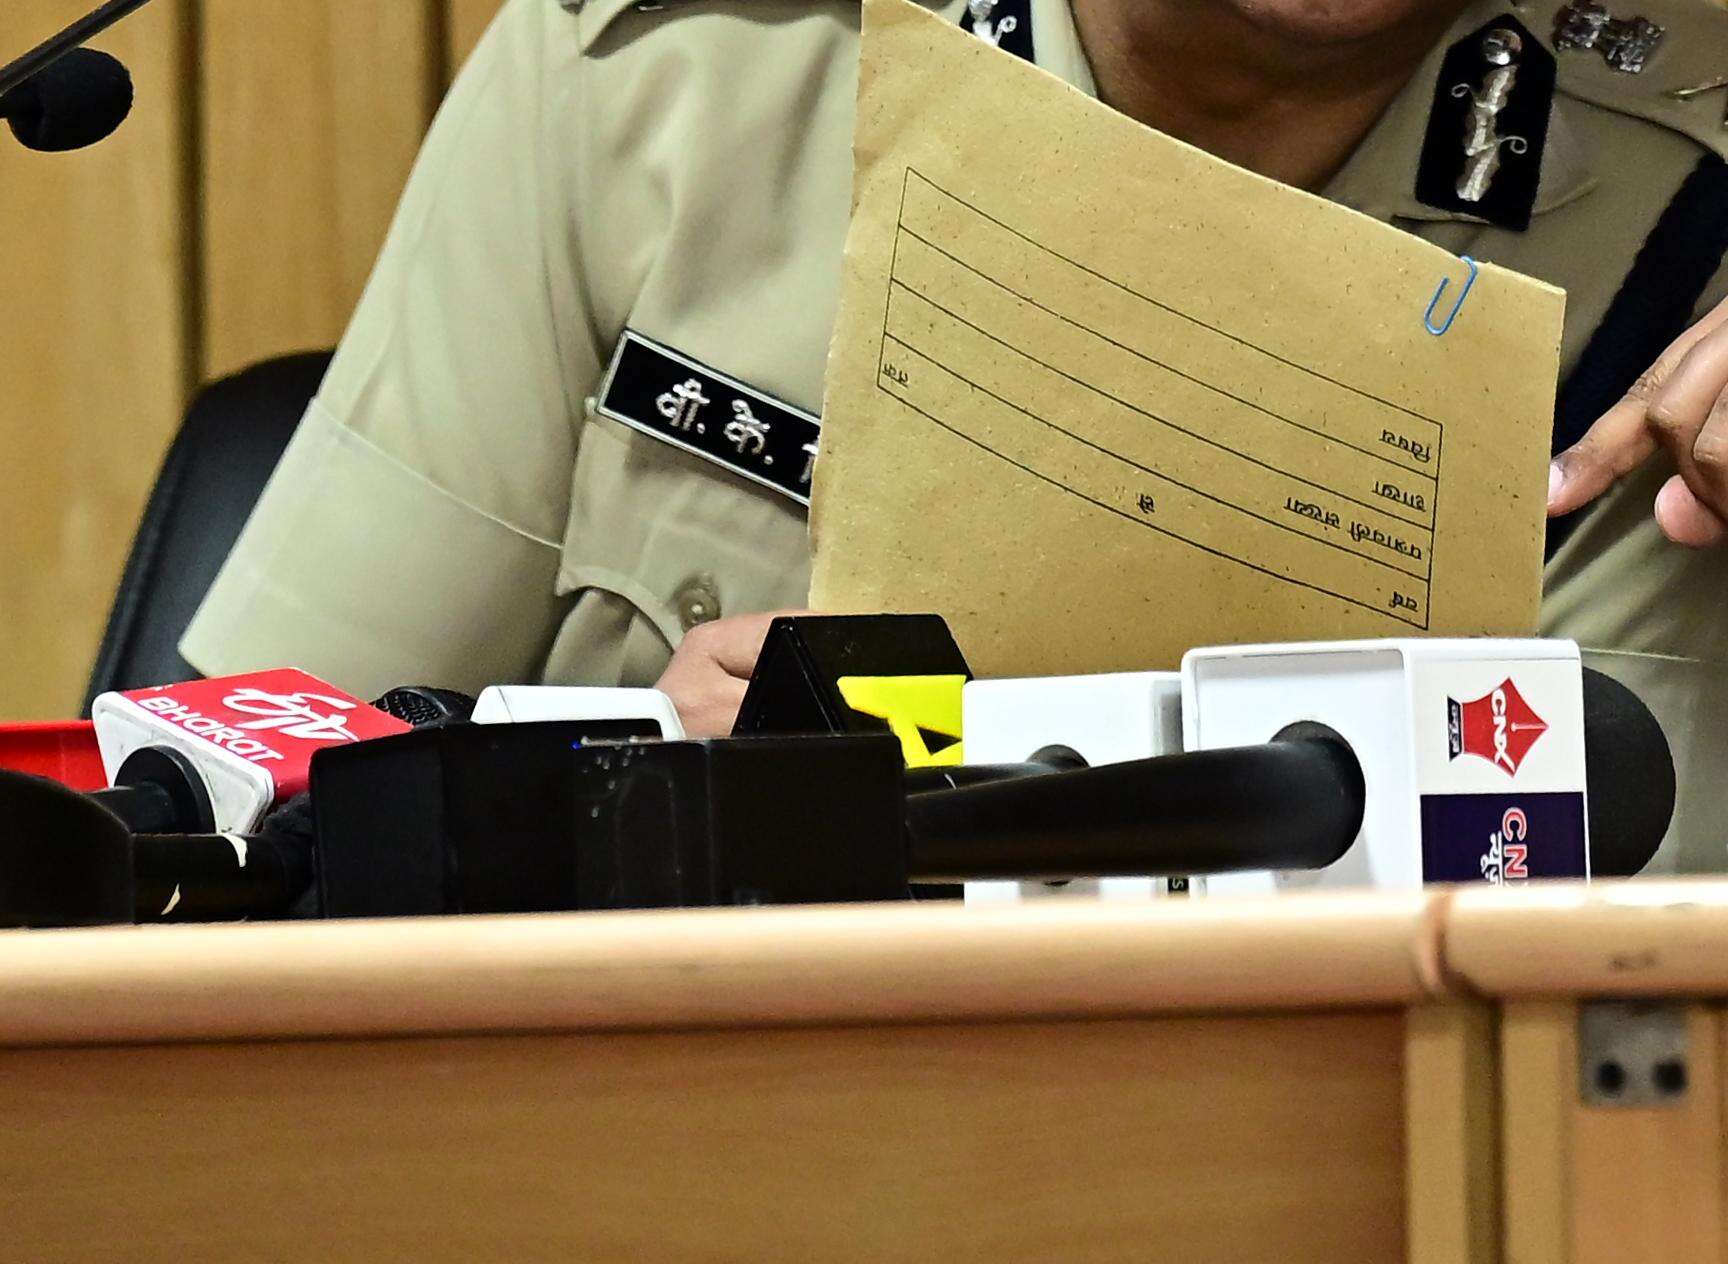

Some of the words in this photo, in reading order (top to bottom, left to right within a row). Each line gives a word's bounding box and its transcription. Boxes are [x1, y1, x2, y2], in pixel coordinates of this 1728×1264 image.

[882, 363, 909, 388] तक
[1378, 429, 1431, 463] विषय
[1283, 496, 1340, 529] संख्या
[1371, 480, 1426, 512] शाखा
[1347, 520, 1422, 560] पत्रावली
[1388, 591, 1419, 613] वर्ष
[1491, 688, 1516, 772] CNX
[1502, 807, 1528, 886] CN
